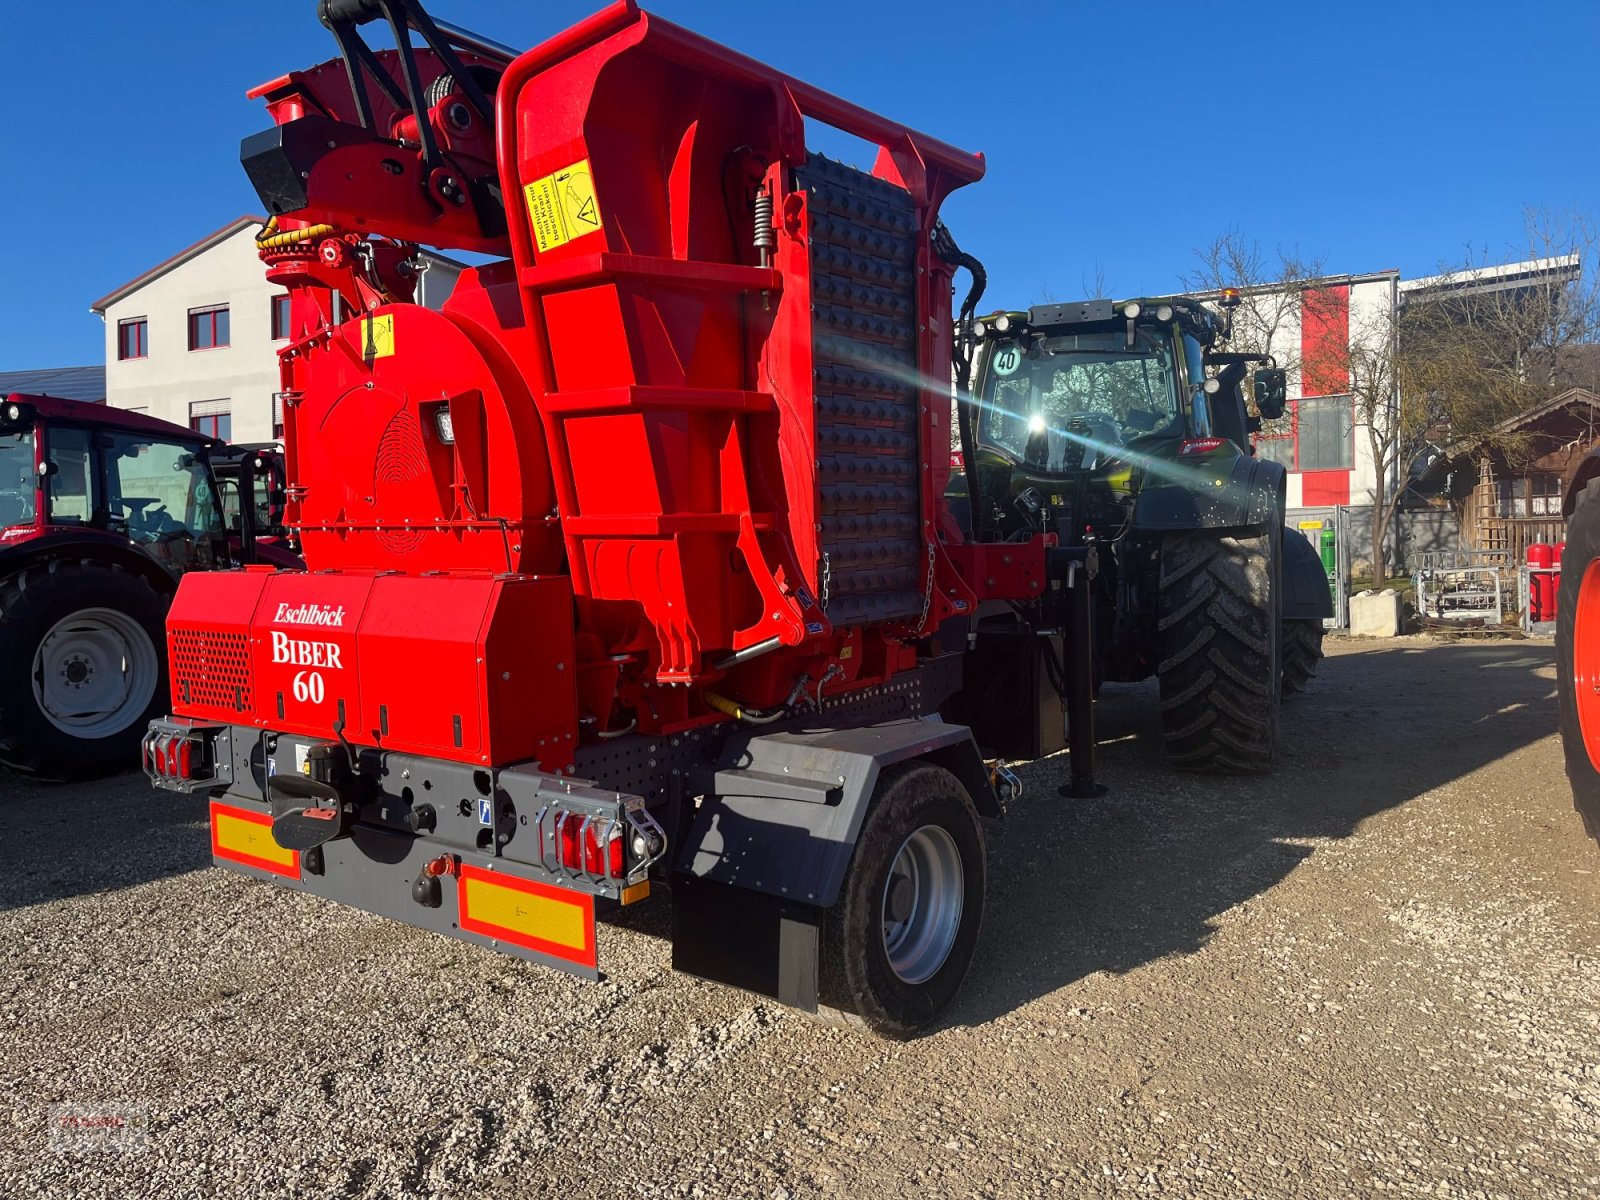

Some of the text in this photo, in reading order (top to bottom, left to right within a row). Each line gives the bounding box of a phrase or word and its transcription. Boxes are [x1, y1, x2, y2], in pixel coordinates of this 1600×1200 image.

[529, 186, 547, 249] Maschine nur
[538, 195, 546, 218] Kran
[541, 183, 560, 241] beschicken!
[998, 353, 1015, 369] 40
[273, 602, 346, 626] Eschlböck
[270, 630, 344, 669] BIBER
[292, 670, 325, 704] 60
